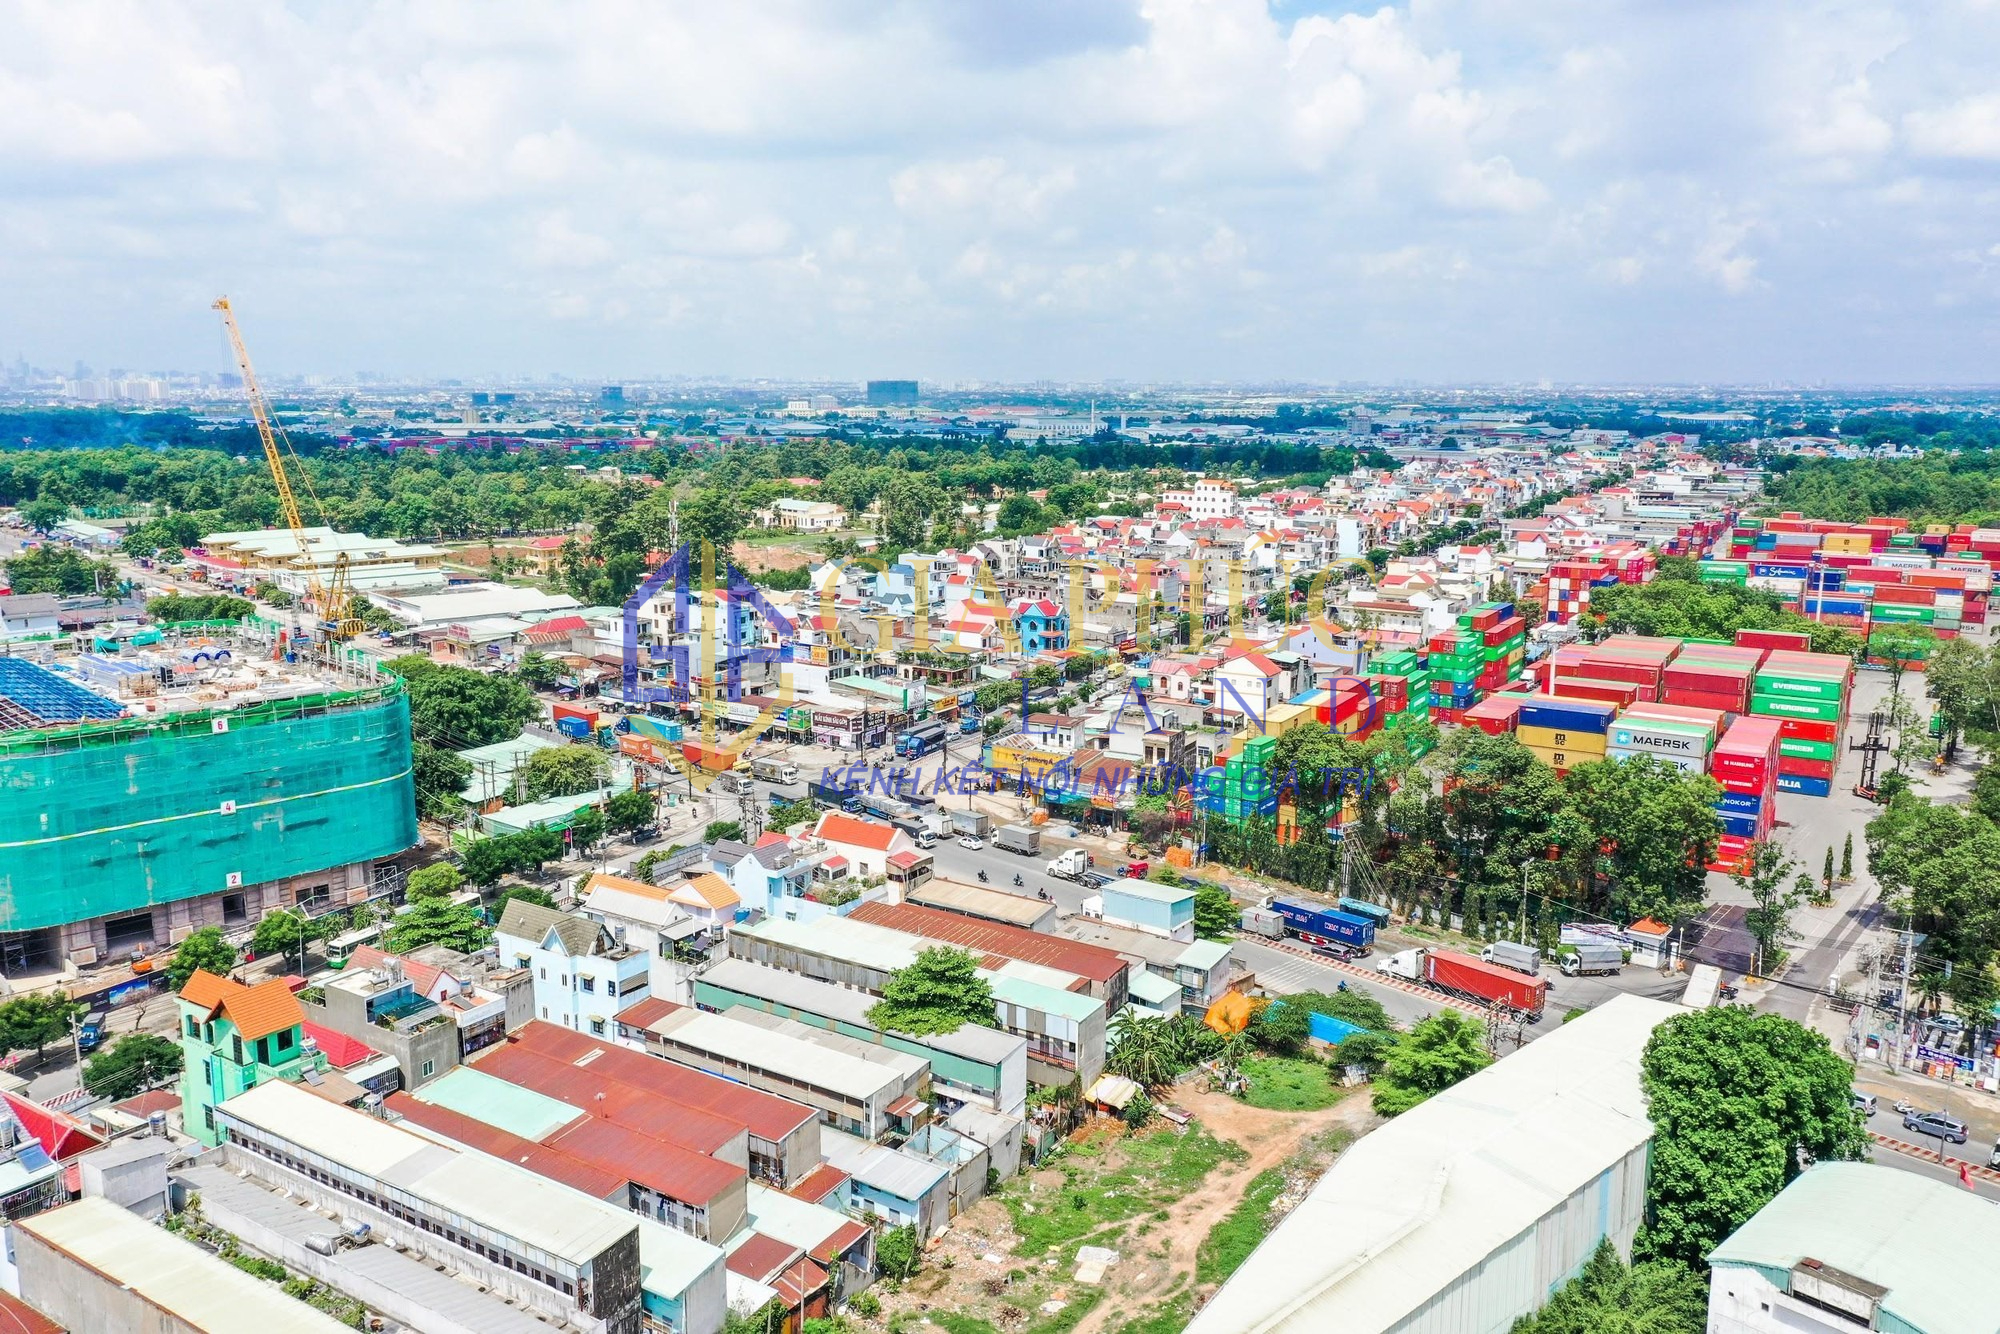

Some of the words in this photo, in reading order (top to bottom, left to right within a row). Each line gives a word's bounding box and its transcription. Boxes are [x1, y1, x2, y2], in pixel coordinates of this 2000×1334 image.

[1772, 682, 1822, 693] EVERGREEN
[1769, 703, 1819, 714] EVERGREEN
[217, 721, 223, 730] 6
[1633, 735, 1691, 750] MAERSK
[1780, 743, 1815, 753] RGREEN
[1777, 778, 1801, 789] ALIA
[226, 803, 231, 811] 4
[1724, 798, 1752, 807] NOKOR
[231, 875, 237, 884] 2
